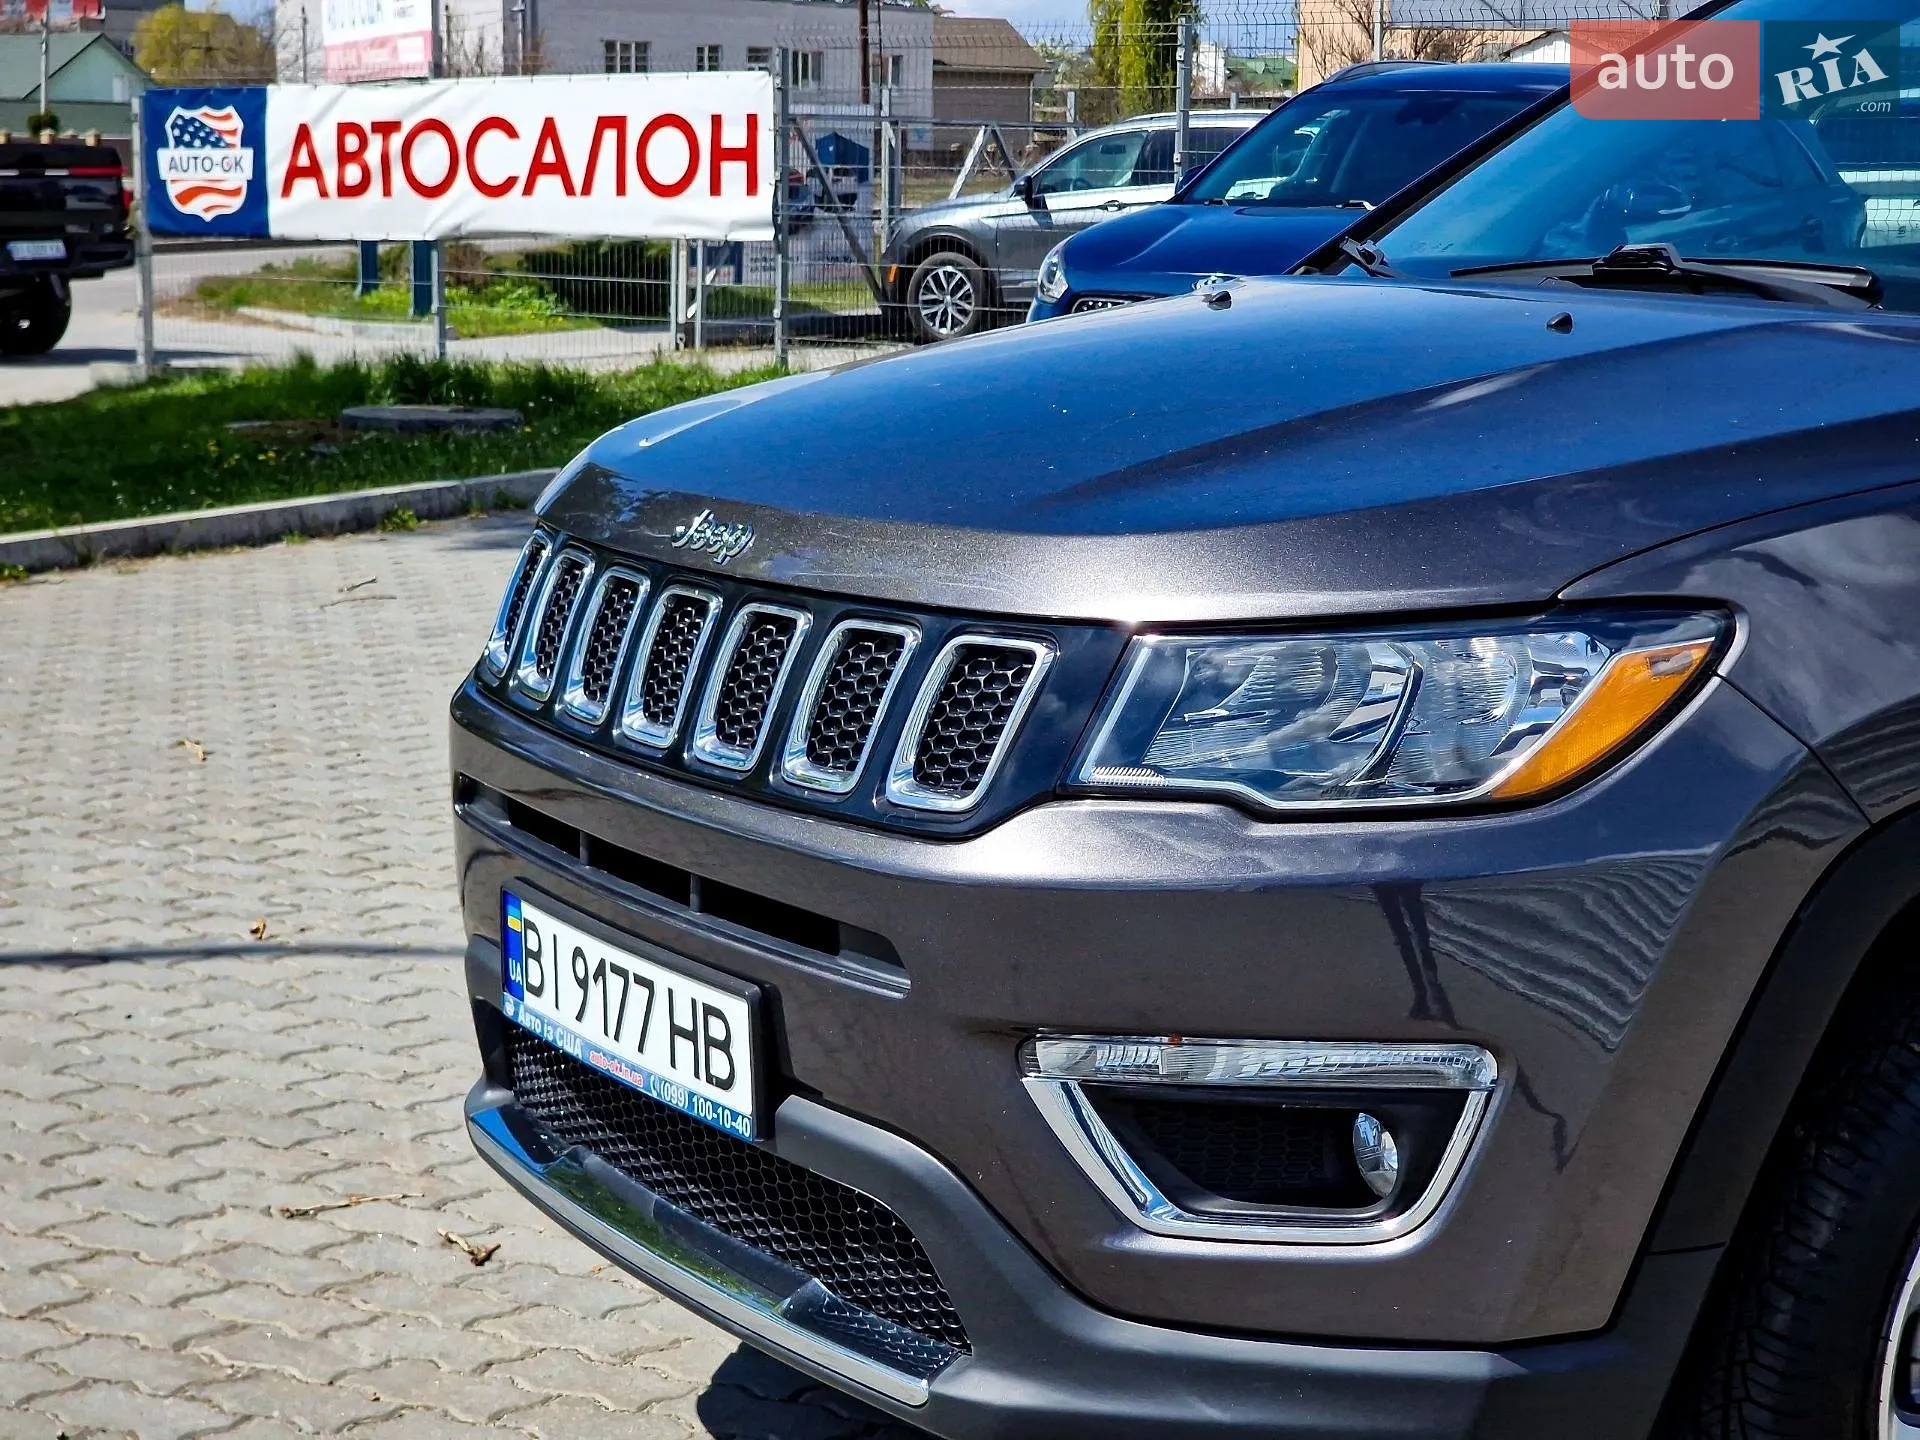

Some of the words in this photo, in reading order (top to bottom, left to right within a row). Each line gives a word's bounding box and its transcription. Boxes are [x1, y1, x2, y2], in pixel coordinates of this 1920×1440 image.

[281, 112, 759, 200] АВТОСАЛОН
[671, 509, 755, 565] Jeep
[508, 957, 523, 986] UA
[572, 946, 655, 1055] 9177
[667, 987, 736, 1092] HB
[660, 1080, 689, 1110] (099)
[692, 1095, 751, 1138] 100-10-40
